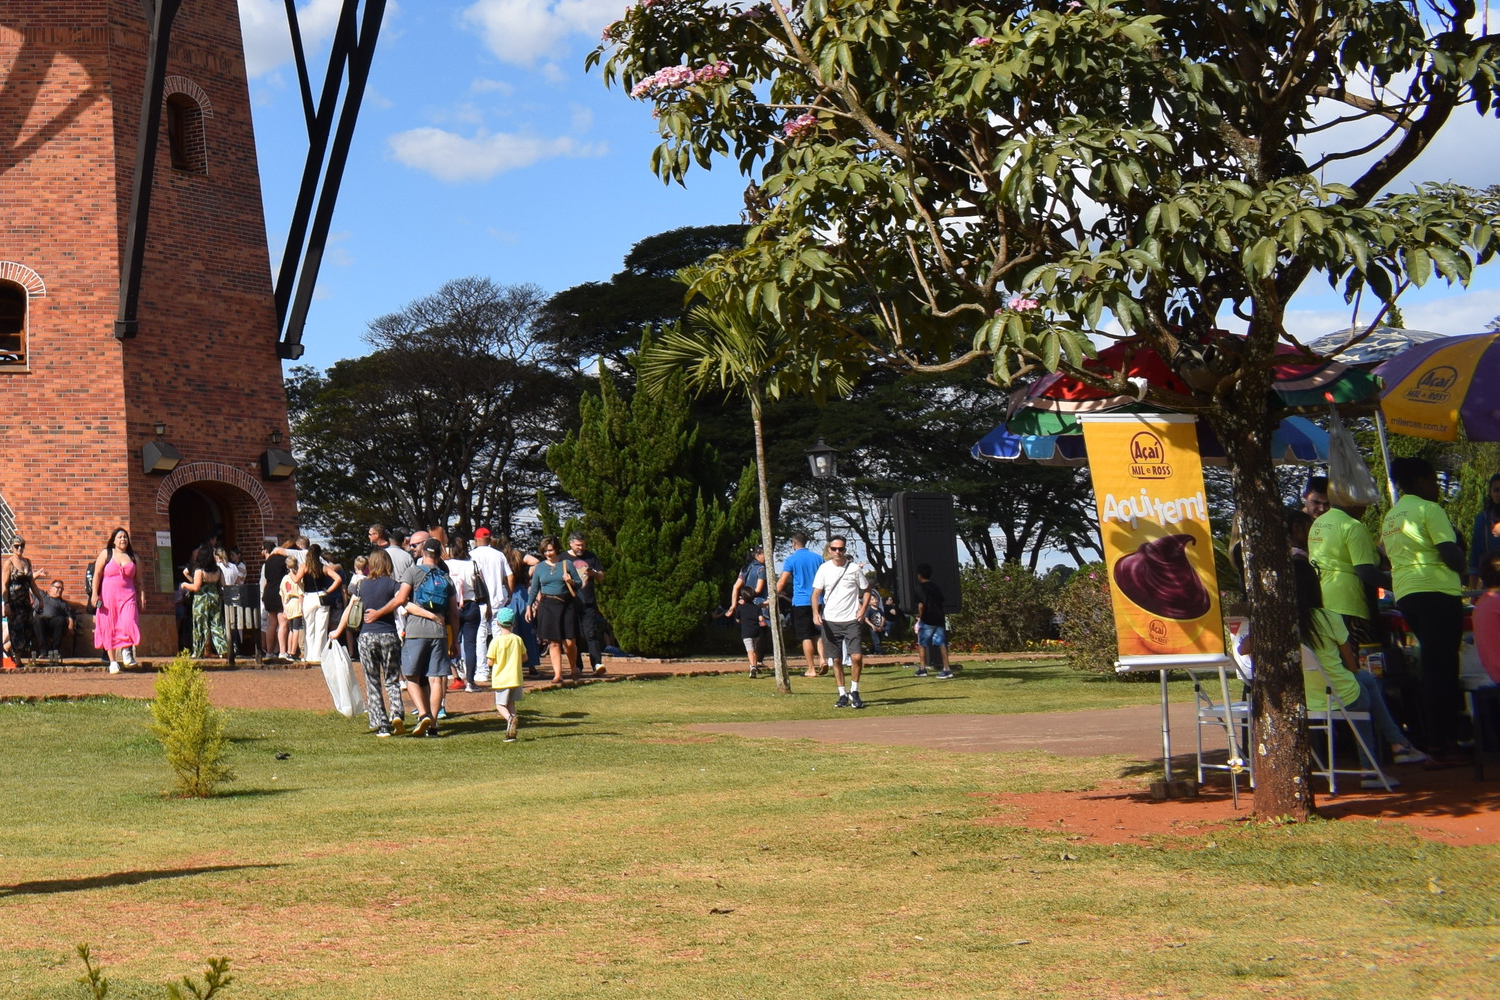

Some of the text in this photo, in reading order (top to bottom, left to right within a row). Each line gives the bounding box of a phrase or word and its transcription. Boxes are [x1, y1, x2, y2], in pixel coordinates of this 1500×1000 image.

[1135, 440, 1159, 461] Açaí
[1132, 466, 1145, 475] MIL
[1152, 466, 1171, 475] ROSS
[1103, 488, 1206, 529] Aqui tem!
